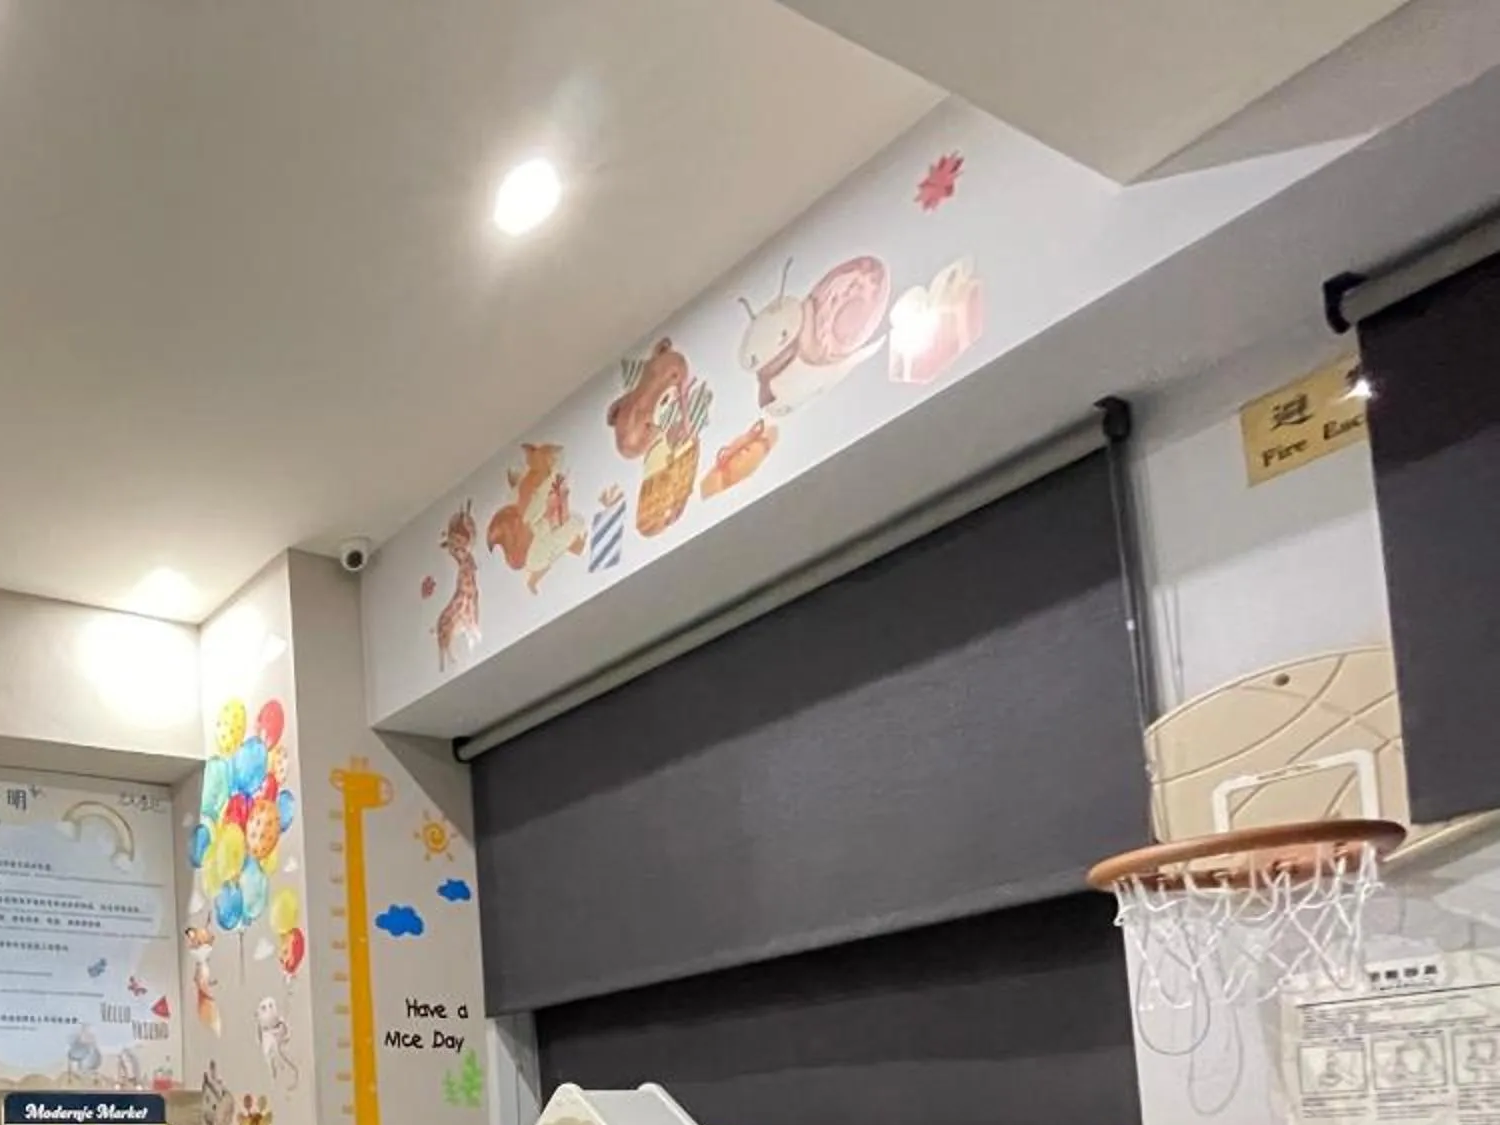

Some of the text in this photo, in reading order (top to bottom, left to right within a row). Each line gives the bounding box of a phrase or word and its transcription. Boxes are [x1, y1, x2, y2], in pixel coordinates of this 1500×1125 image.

[1263, 440, 1308, 467] Fire
[405, 998, 469, 1020] Have a
[432, 1029, 466, 1054] Day
[96, 1103, 149, 1120] Market
